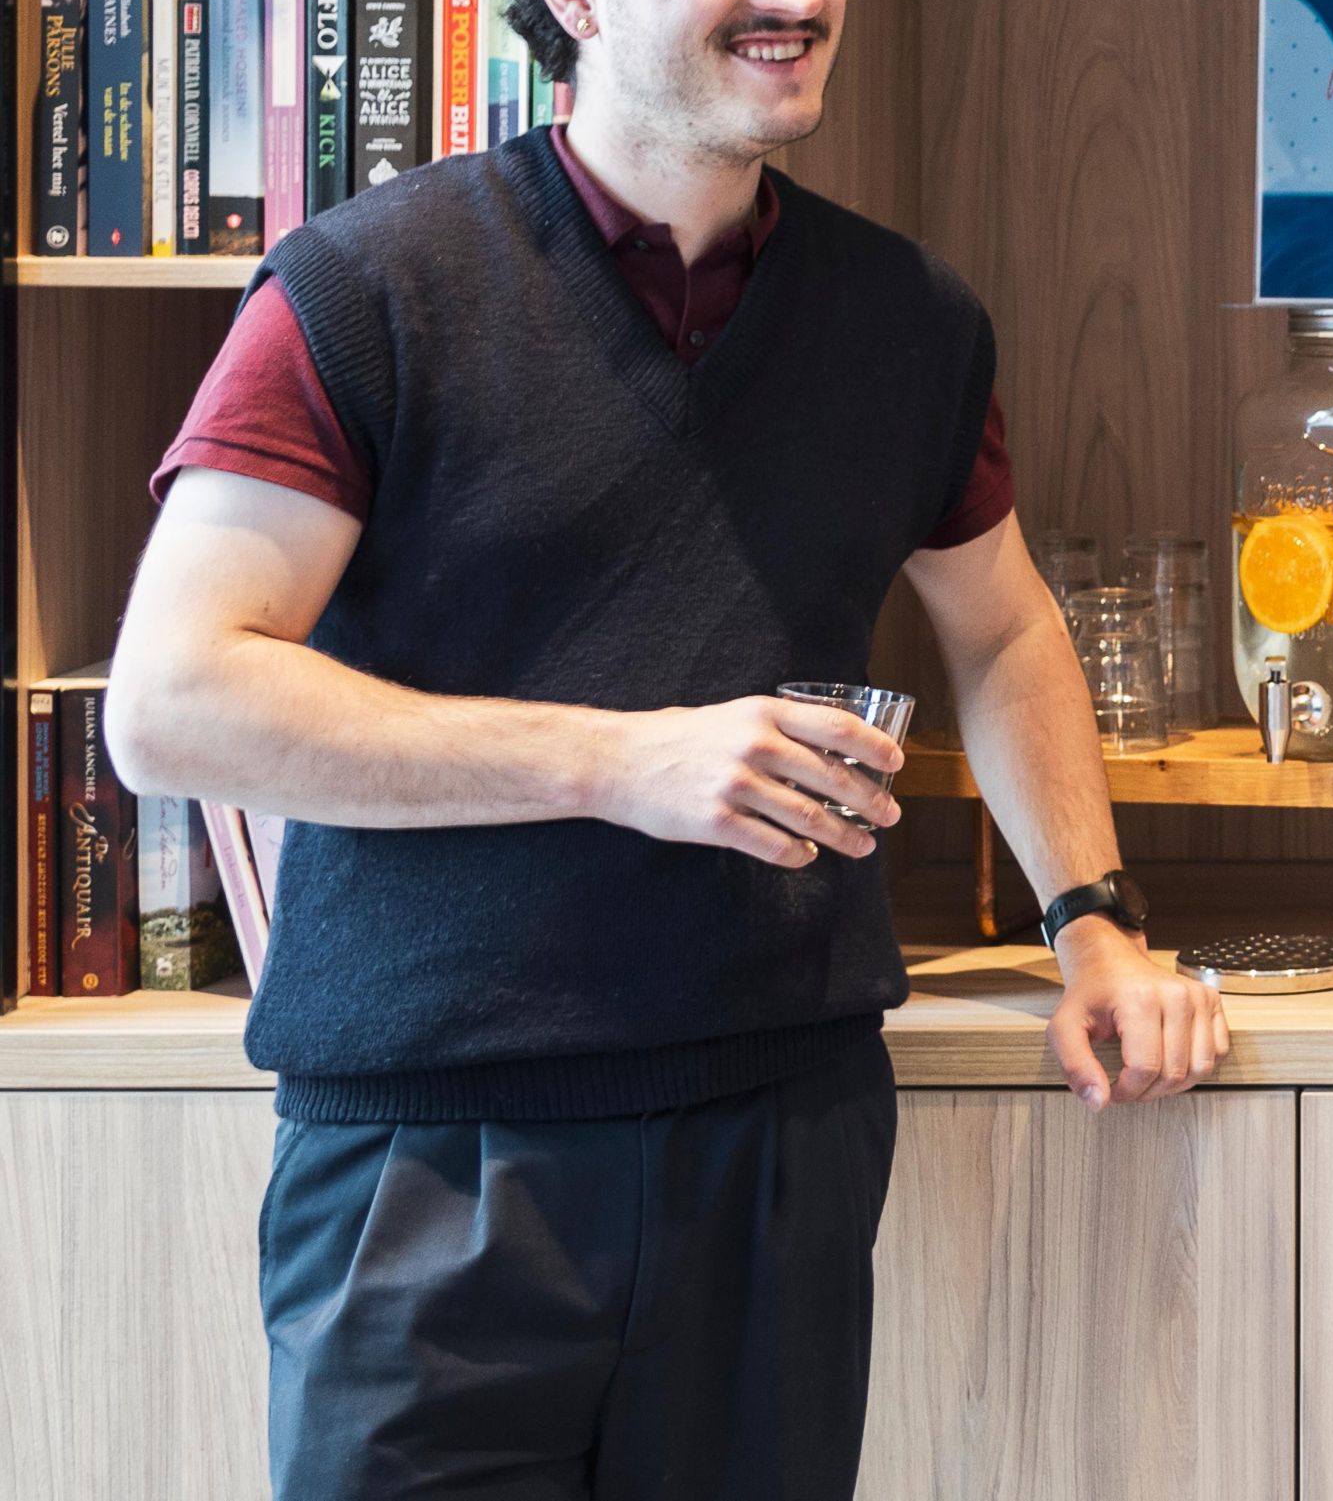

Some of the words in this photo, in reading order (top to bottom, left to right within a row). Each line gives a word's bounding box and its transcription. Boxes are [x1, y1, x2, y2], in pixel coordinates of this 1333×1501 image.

[45, 15, 64, 97] PARSONS
[60, 27, 77, 72] JULIE
[360, 65, 410, 79] ALICE
[360, 101, 409, 115] ALICE
[318, 113, 336, 168] KICK
[69, 802, 98, 950] ANTIQUAIR
